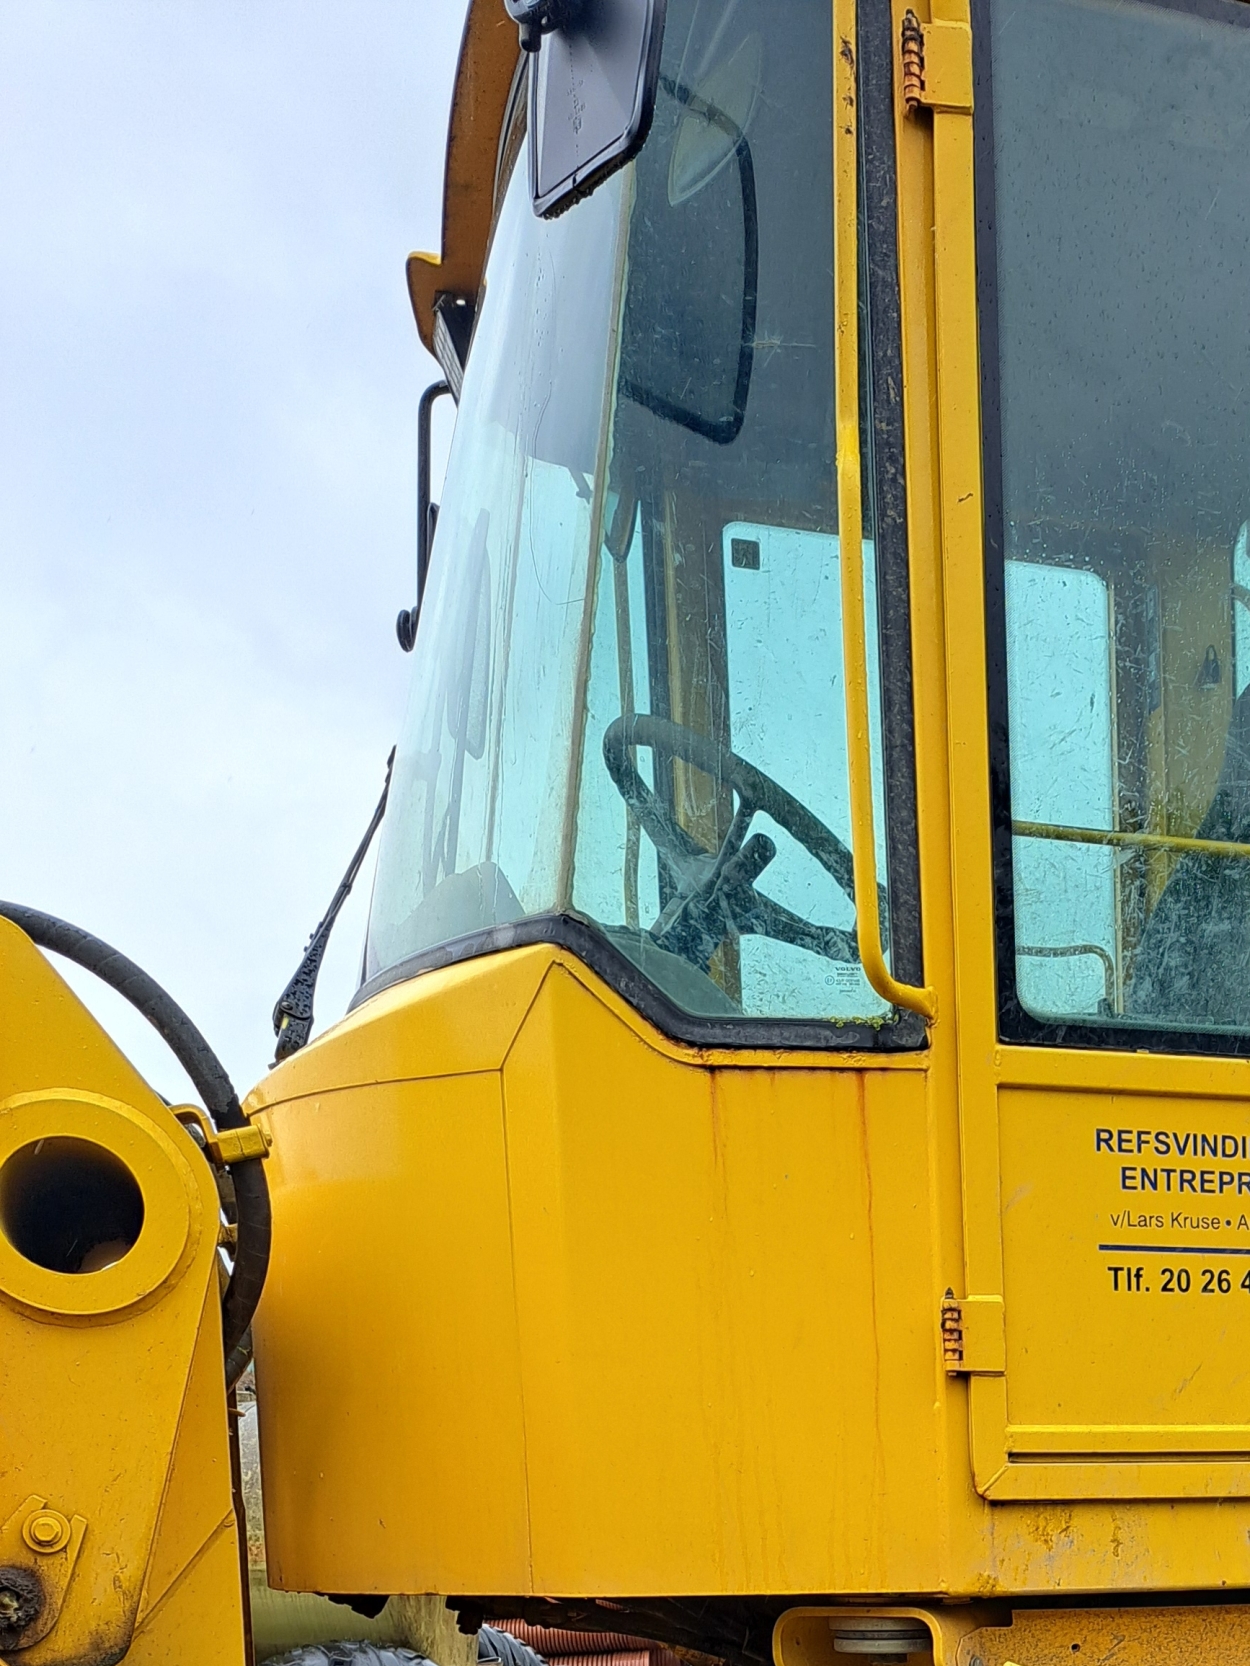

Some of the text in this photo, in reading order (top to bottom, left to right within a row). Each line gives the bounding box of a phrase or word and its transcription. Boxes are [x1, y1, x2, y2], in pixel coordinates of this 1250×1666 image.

[1110, 1210, 1164, 1230] v/Lars
[1170, 1212, 1221, 1231] Kruse
[1107, 1266, 1151, 1292] Tlf.
[1160, 1268, 1191, 1294] 20
[1201, 1268, 1232, 1294] 26
